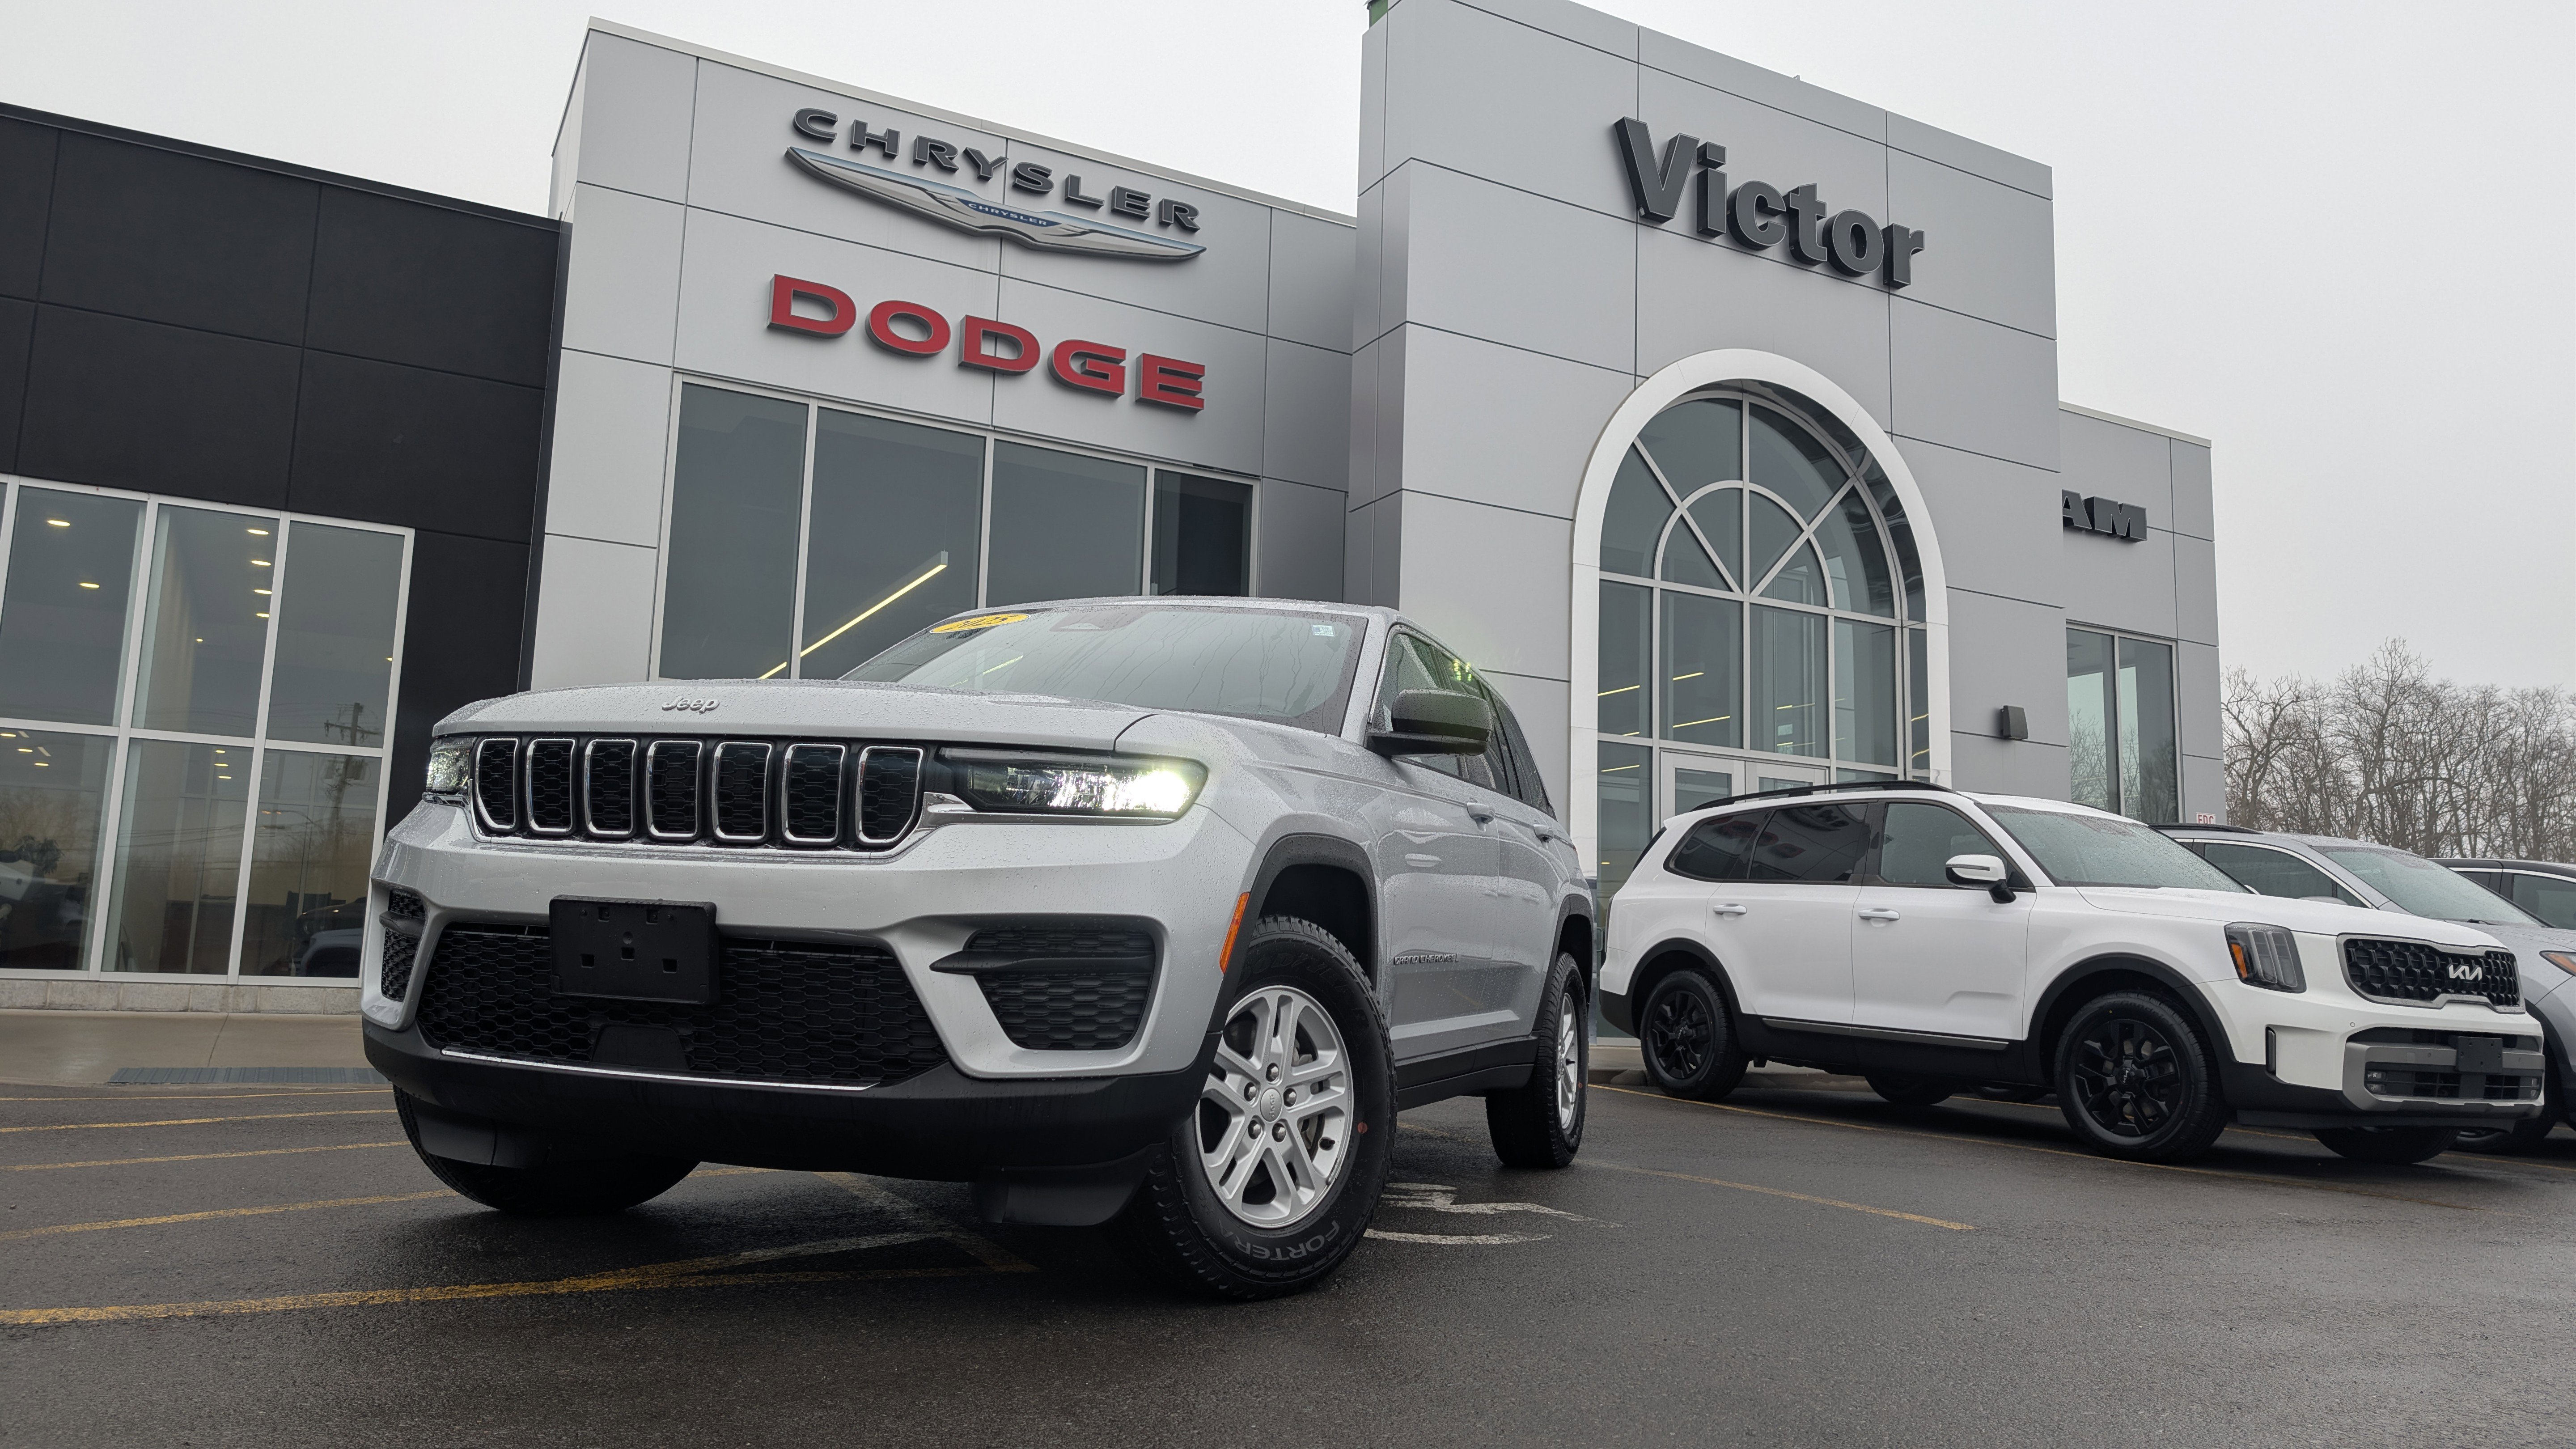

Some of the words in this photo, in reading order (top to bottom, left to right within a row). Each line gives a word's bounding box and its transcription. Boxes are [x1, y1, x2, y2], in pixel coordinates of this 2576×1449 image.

[792, 107, 1201, 232] CHRYSLER
[968, 203, 1047, 226] CHRYSLER
[1614, 116, 1925, 289] Victor
[767, 274, 1206, 413] DODGE
[2061, 488, 2148, 542] AM
[661, 696, 720, 715] Jeep
[2198, 814, 2214, 824] FDC
[1394, 955, 1418, 965] GRAND
[1419, 953, 1456, 962] CHEROKEE
[1219, 1219, 1340, 1261] FORTERA
